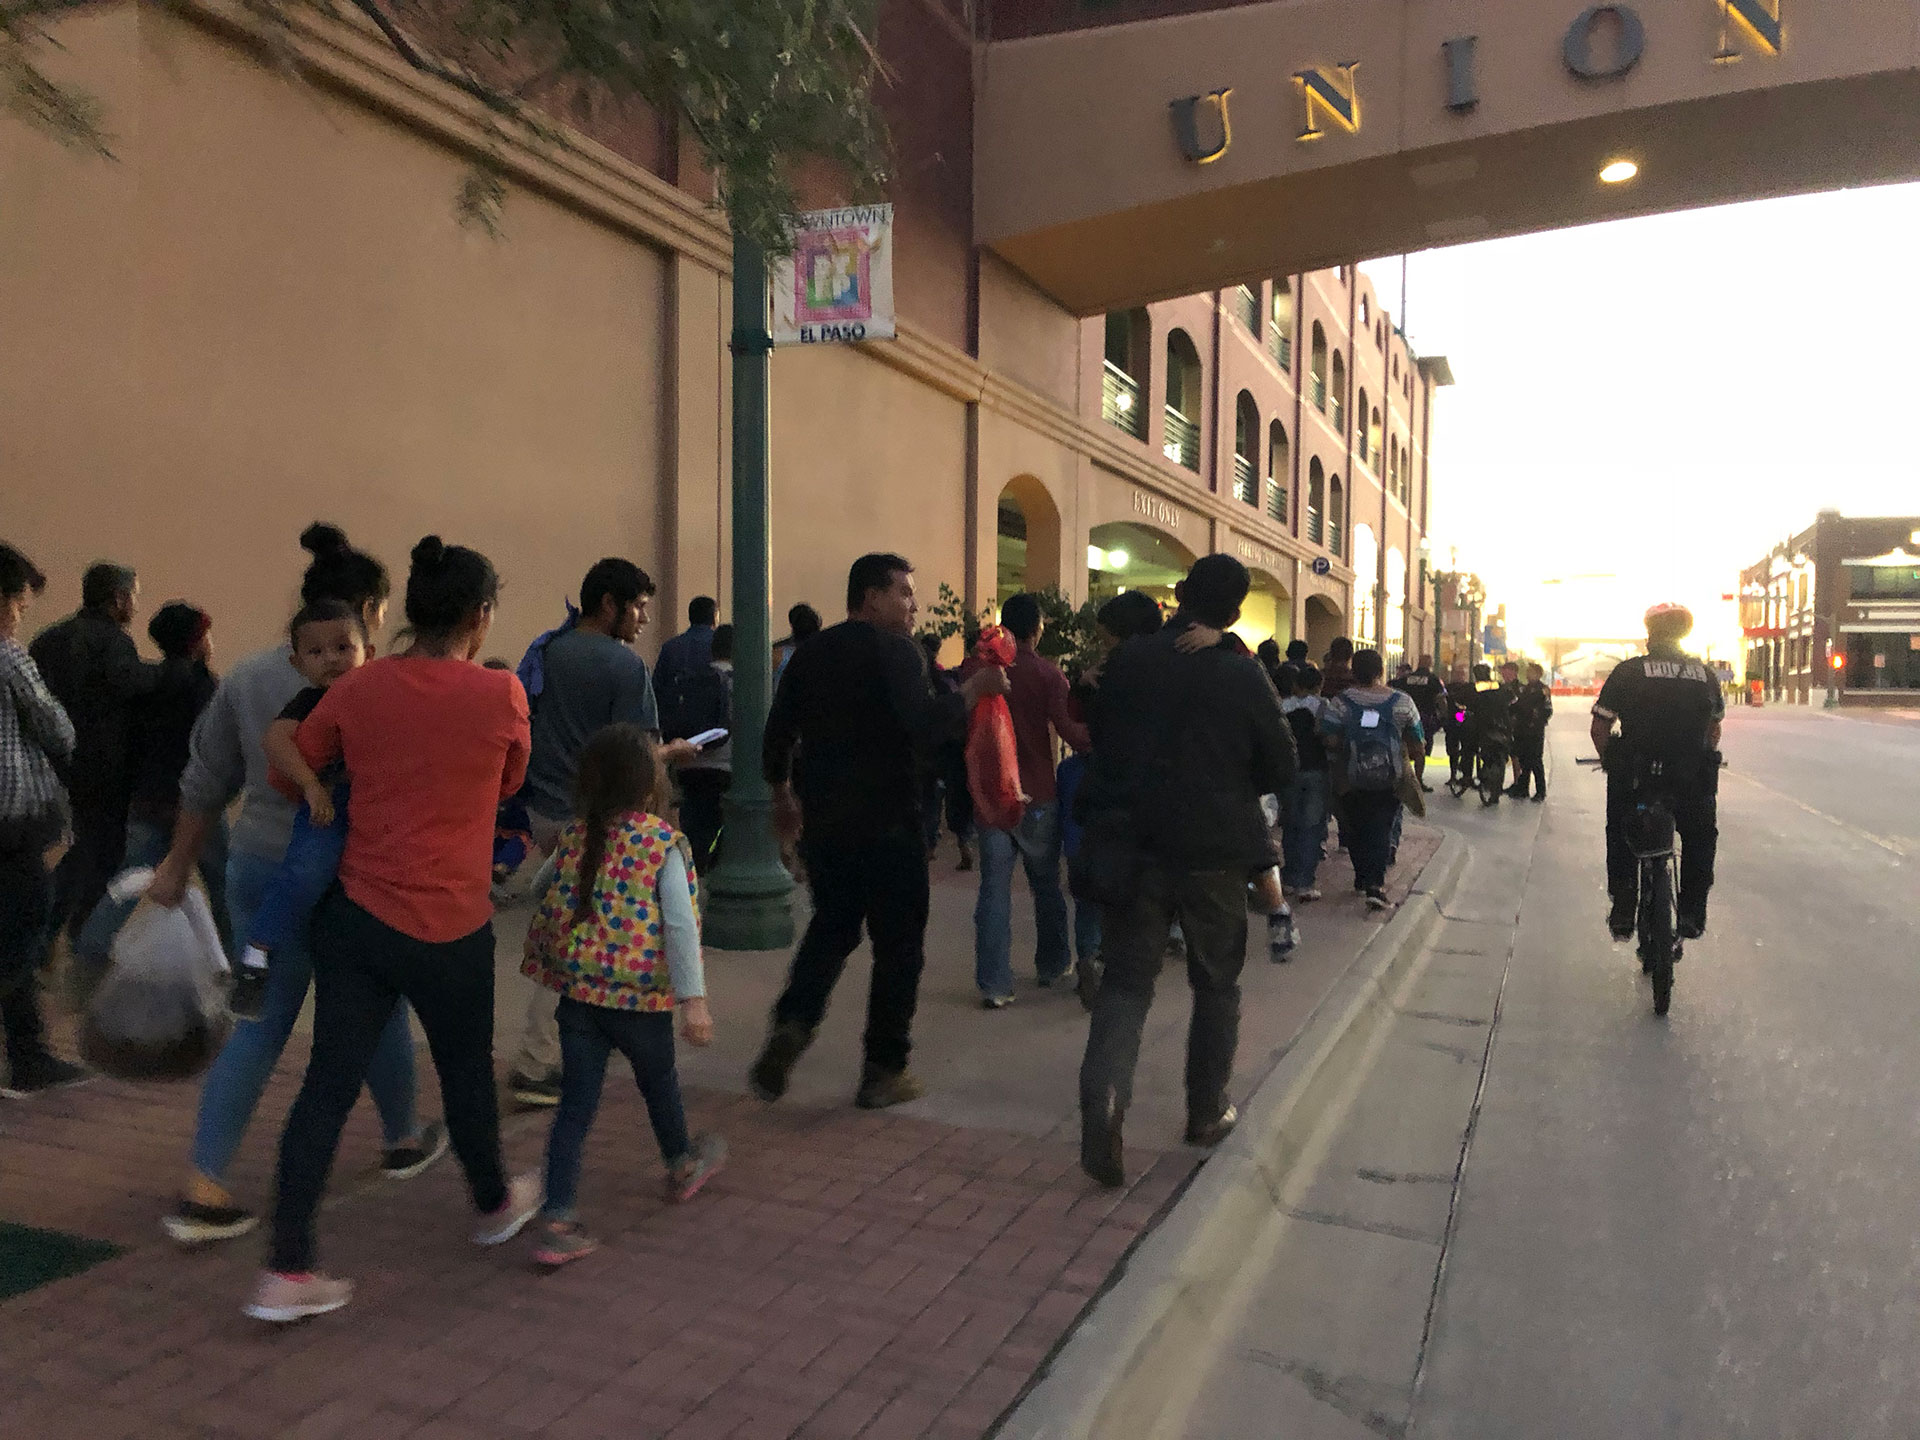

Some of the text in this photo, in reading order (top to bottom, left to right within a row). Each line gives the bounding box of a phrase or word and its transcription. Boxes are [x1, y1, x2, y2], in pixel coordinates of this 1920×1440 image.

[1168, 0, 1785, 165] UNION
[800, 204, 887, 231] WNTOWN
[800, 322, 866, 343] EL PASO
